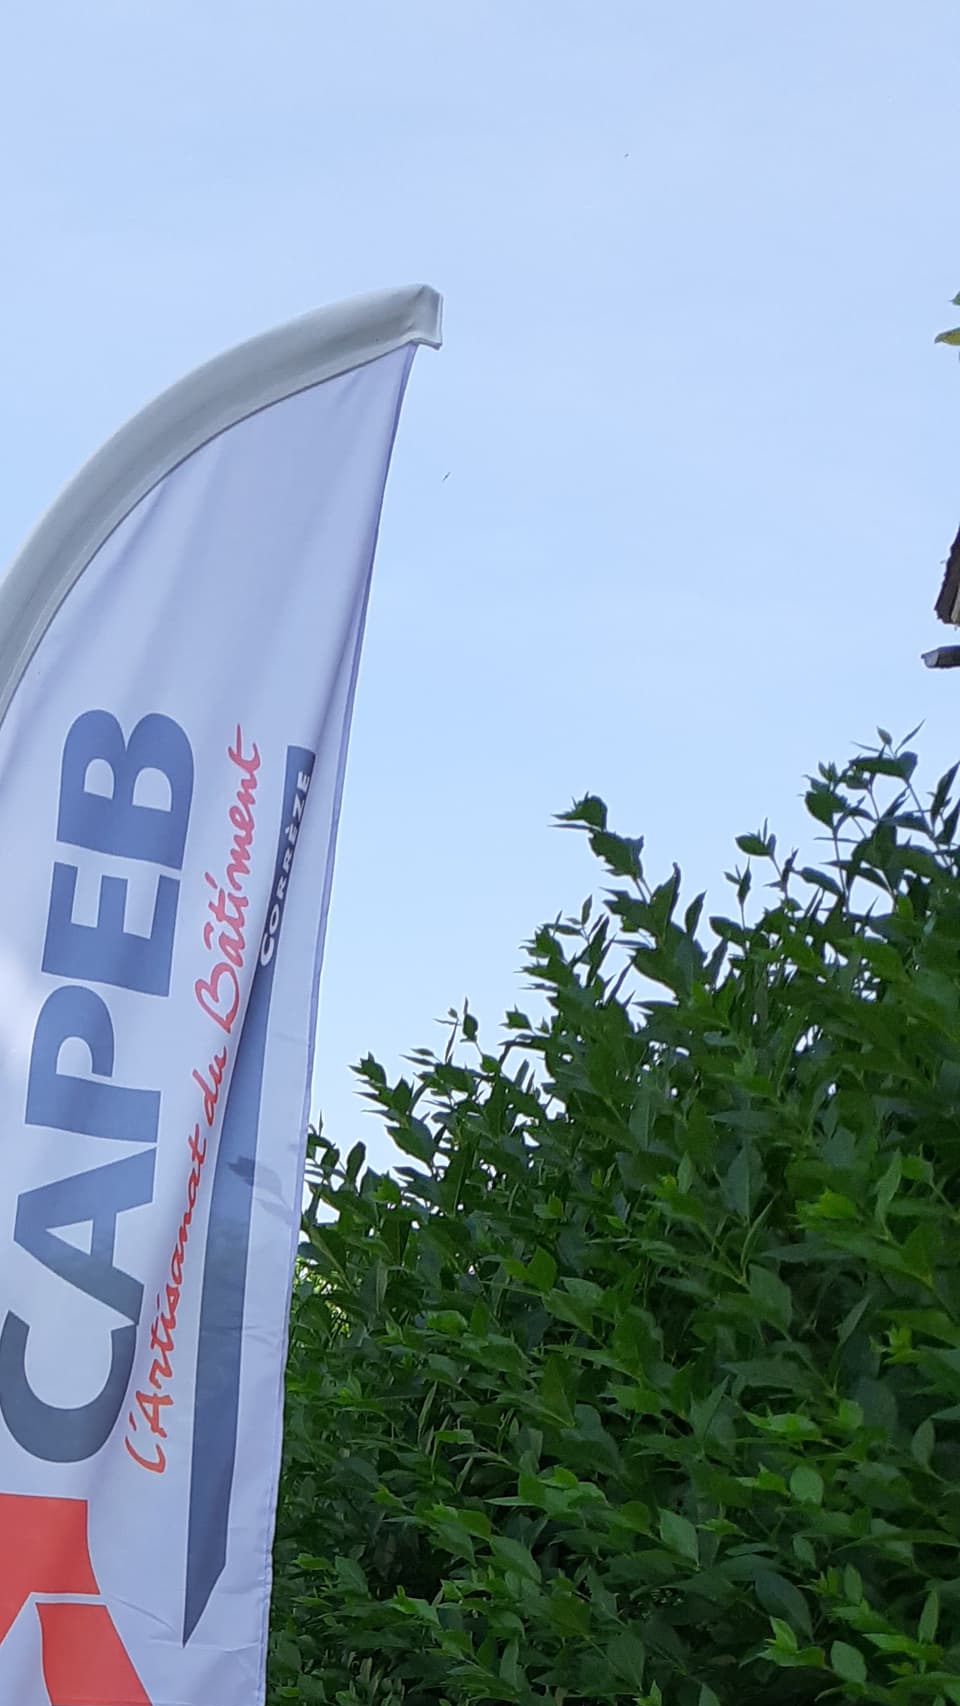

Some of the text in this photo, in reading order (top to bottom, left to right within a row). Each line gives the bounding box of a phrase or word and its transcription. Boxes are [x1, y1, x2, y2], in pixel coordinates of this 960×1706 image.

[195, 723, 262, 1035] Bâtiment
[260, 770, 312, 967] CORRÈZE
[192, 1045, 229, 1128] du
